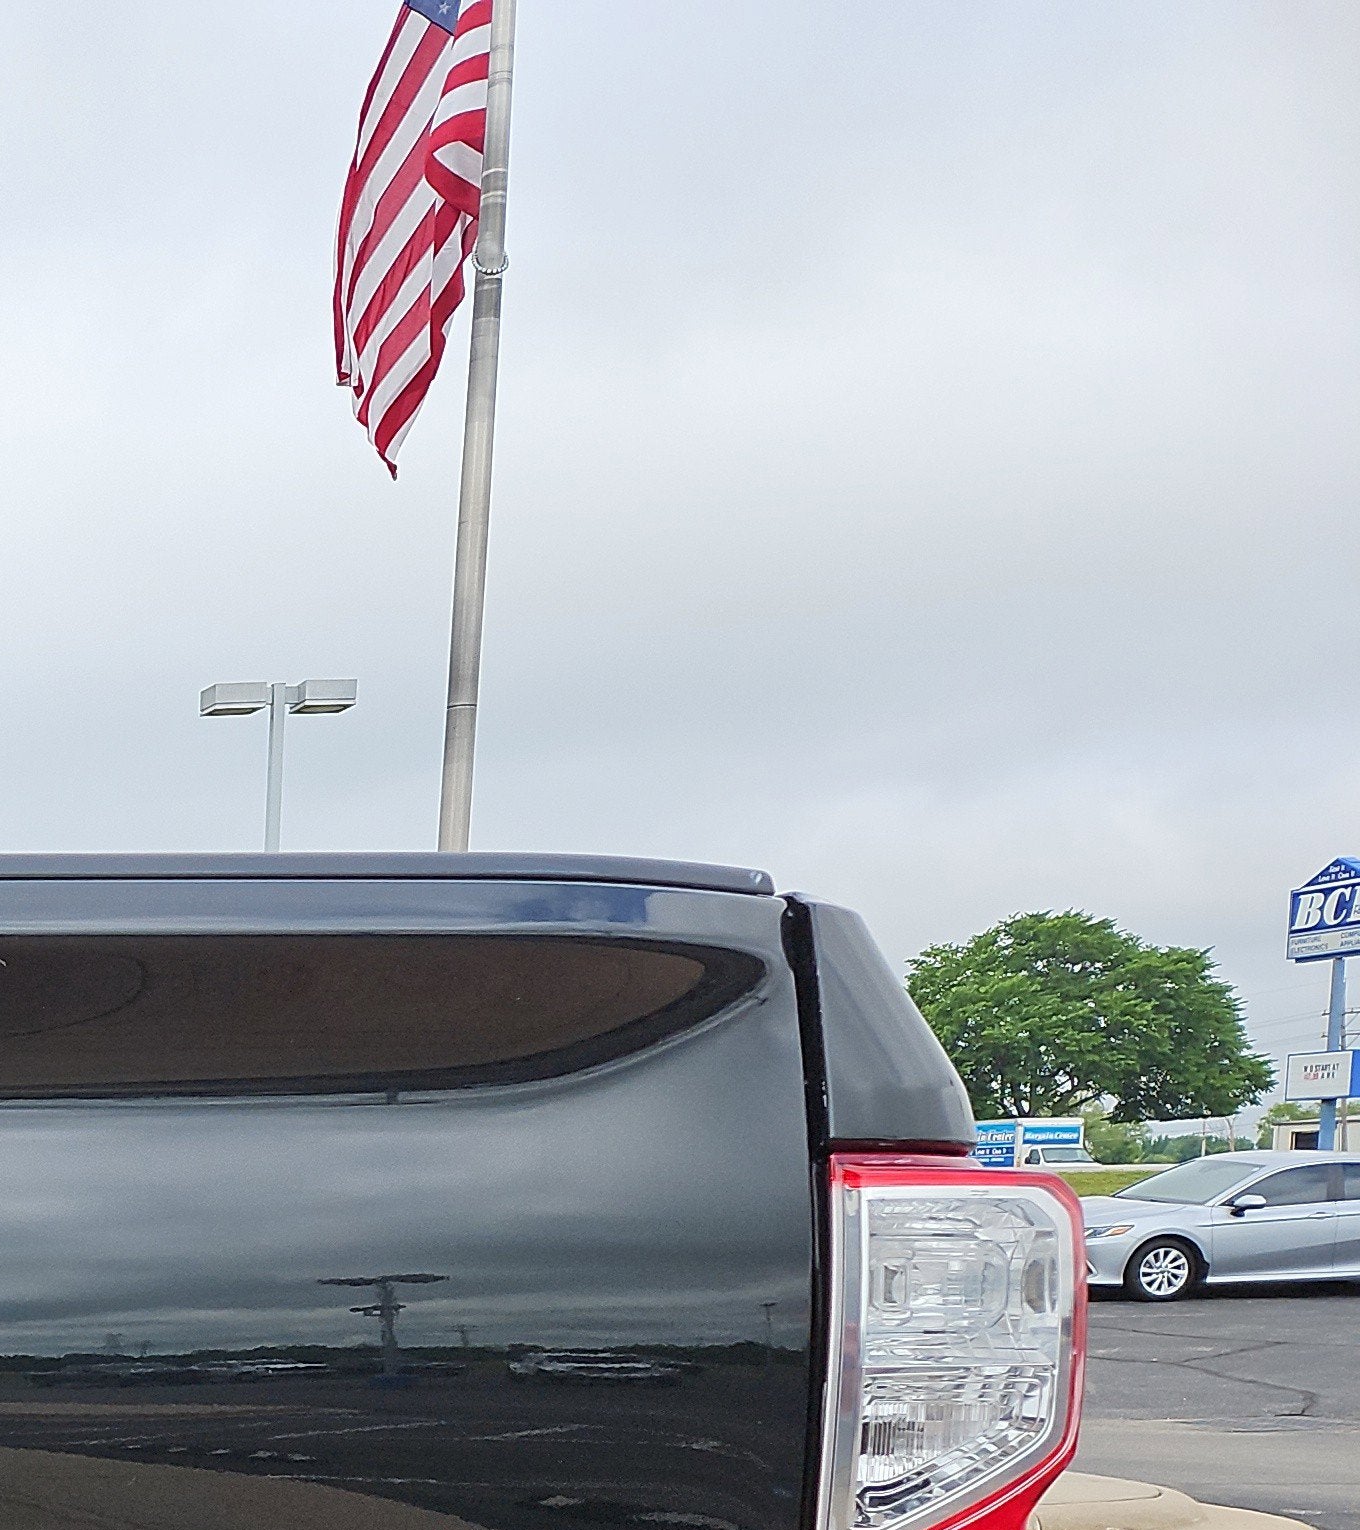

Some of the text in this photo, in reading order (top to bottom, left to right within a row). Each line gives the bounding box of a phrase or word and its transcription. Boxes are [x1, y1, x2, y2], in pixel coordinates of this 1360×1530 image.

[988, 1132, 1014, 1141] Center
[1024, 1131, 1079, 1141] Bargain Center
